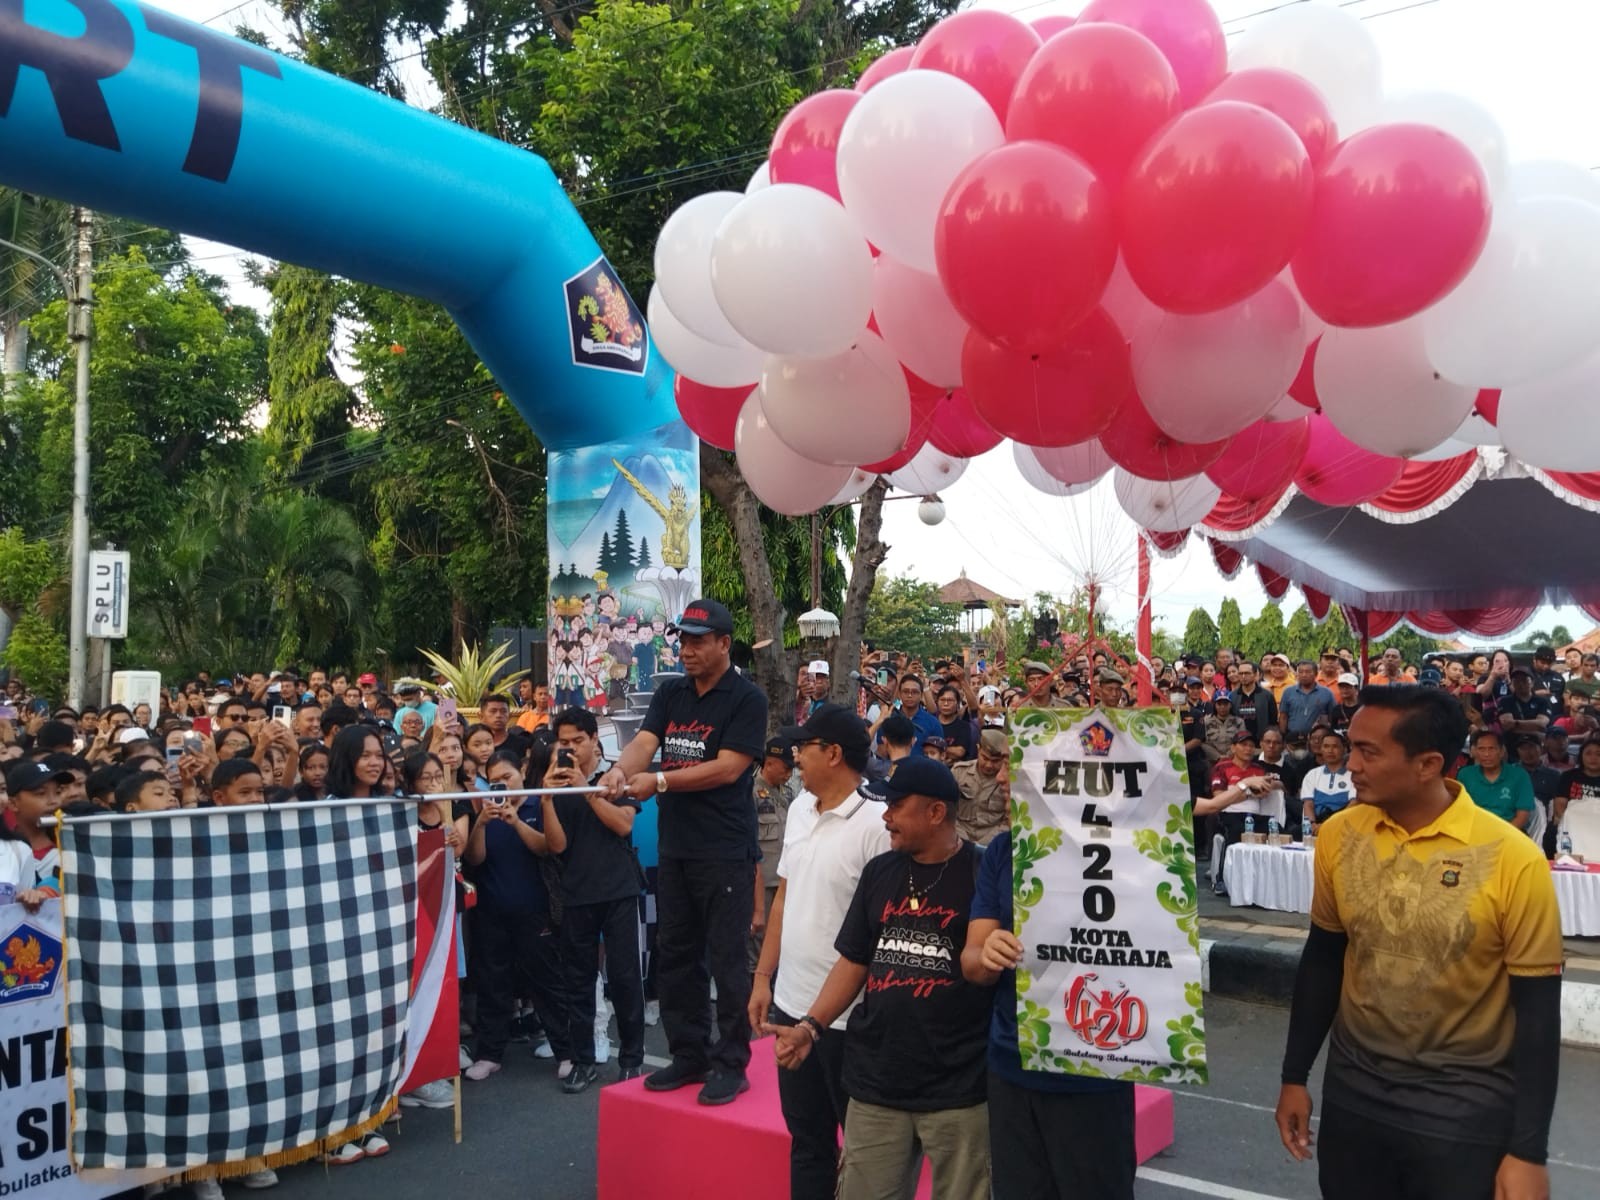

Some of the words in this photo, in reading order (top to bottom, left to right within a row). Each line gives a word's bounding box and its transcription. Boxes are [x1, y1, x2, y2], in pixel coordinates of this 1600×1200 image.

[0, 0, 283, 183] RT
[95, 564, 111, 623] SPLU
[37, 763, 51, 772] R
[1042, 760, 1148, 798] HUT
[1070, 927, 1133, 948] KOTA
[1036, 944, 1173, 969] SINGARAJA
[0, 1163, 77, 1197] bulatka
